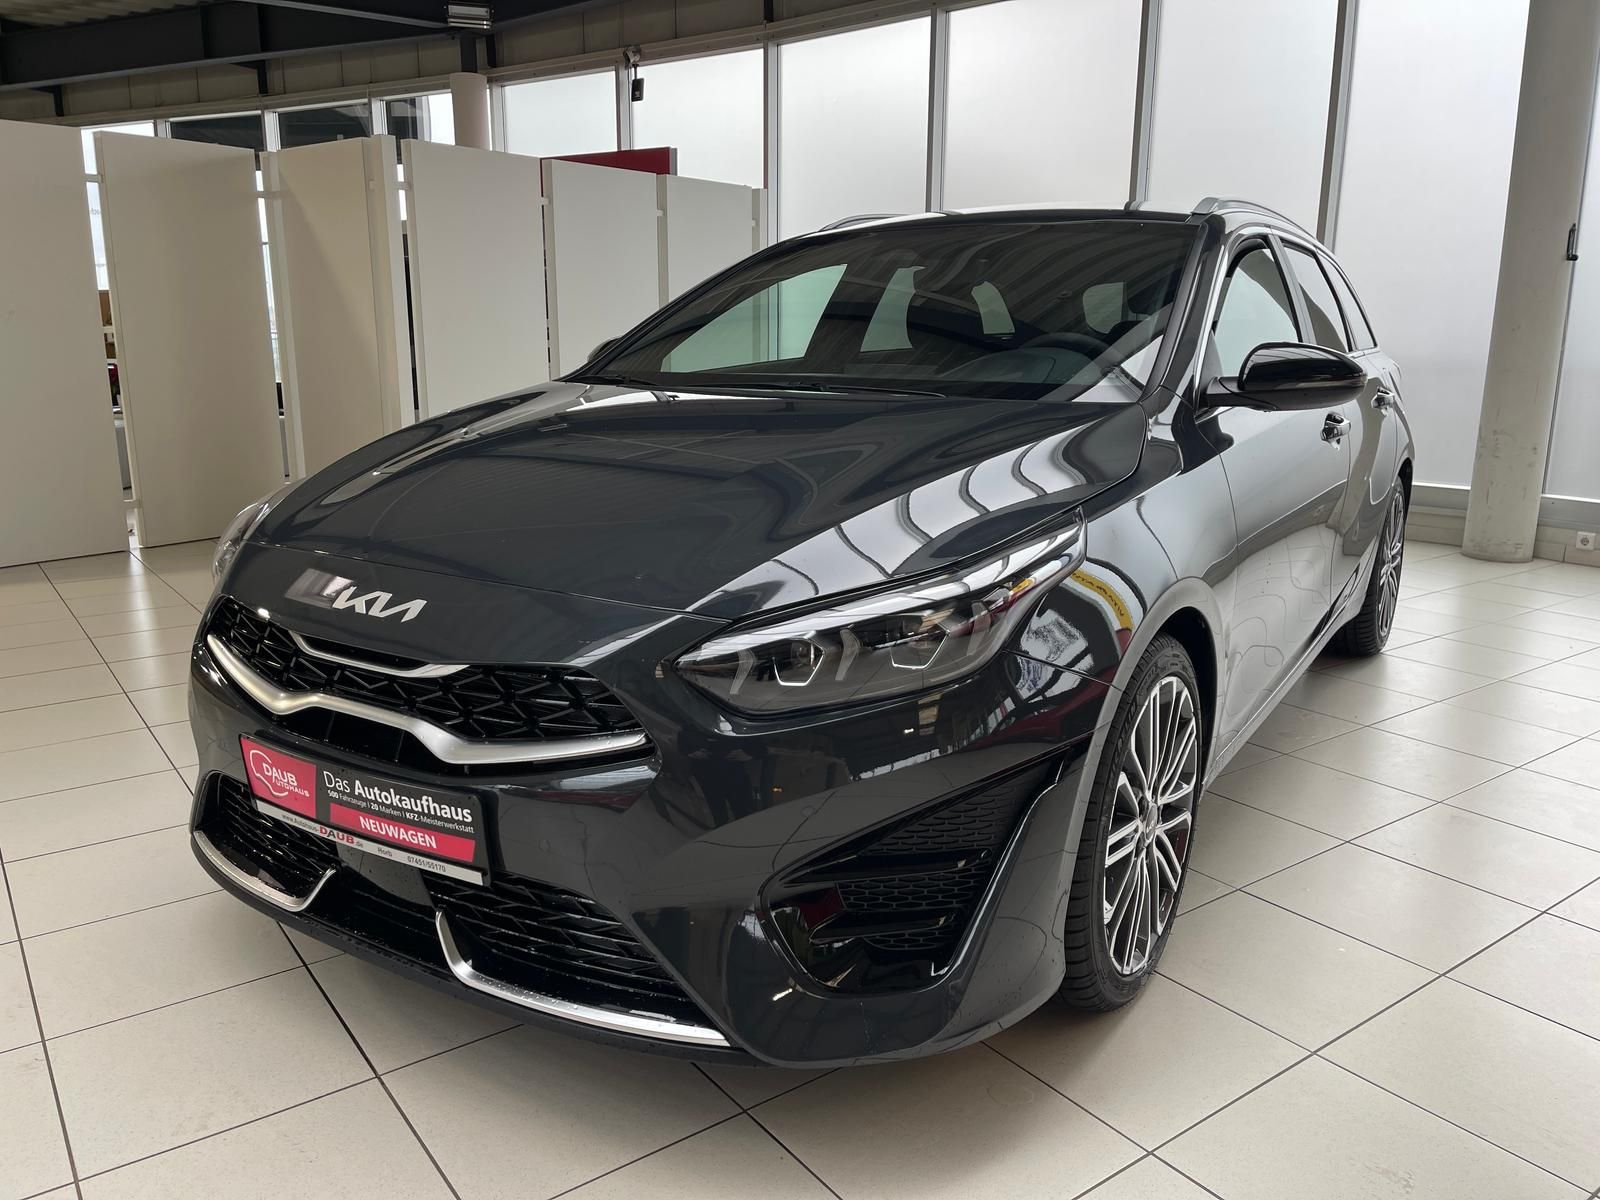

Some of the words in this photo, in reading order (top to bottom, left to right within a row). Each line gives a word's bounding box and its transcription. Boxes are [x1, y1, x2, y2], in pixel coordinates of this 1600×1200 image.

[332, 586, 427, 622] KIA
[262, 762, 298, 786] DAUB
[323, 771, 351, 793] Das
[354, 779, 473, 823] Autokaufhaus
[327, 789, 339, 799] 500
[339, 793, 367, 809] Fahrzeuge
[370, 802, 379, 811] 20
[379, 805, 402, 817] Marken
[405, 811, 475, 834] KFZ-Meisterwerkstatt
[359, 816, 438, 849] NEUWAGEN
[407, 855, 447, 873] 07451/55170
